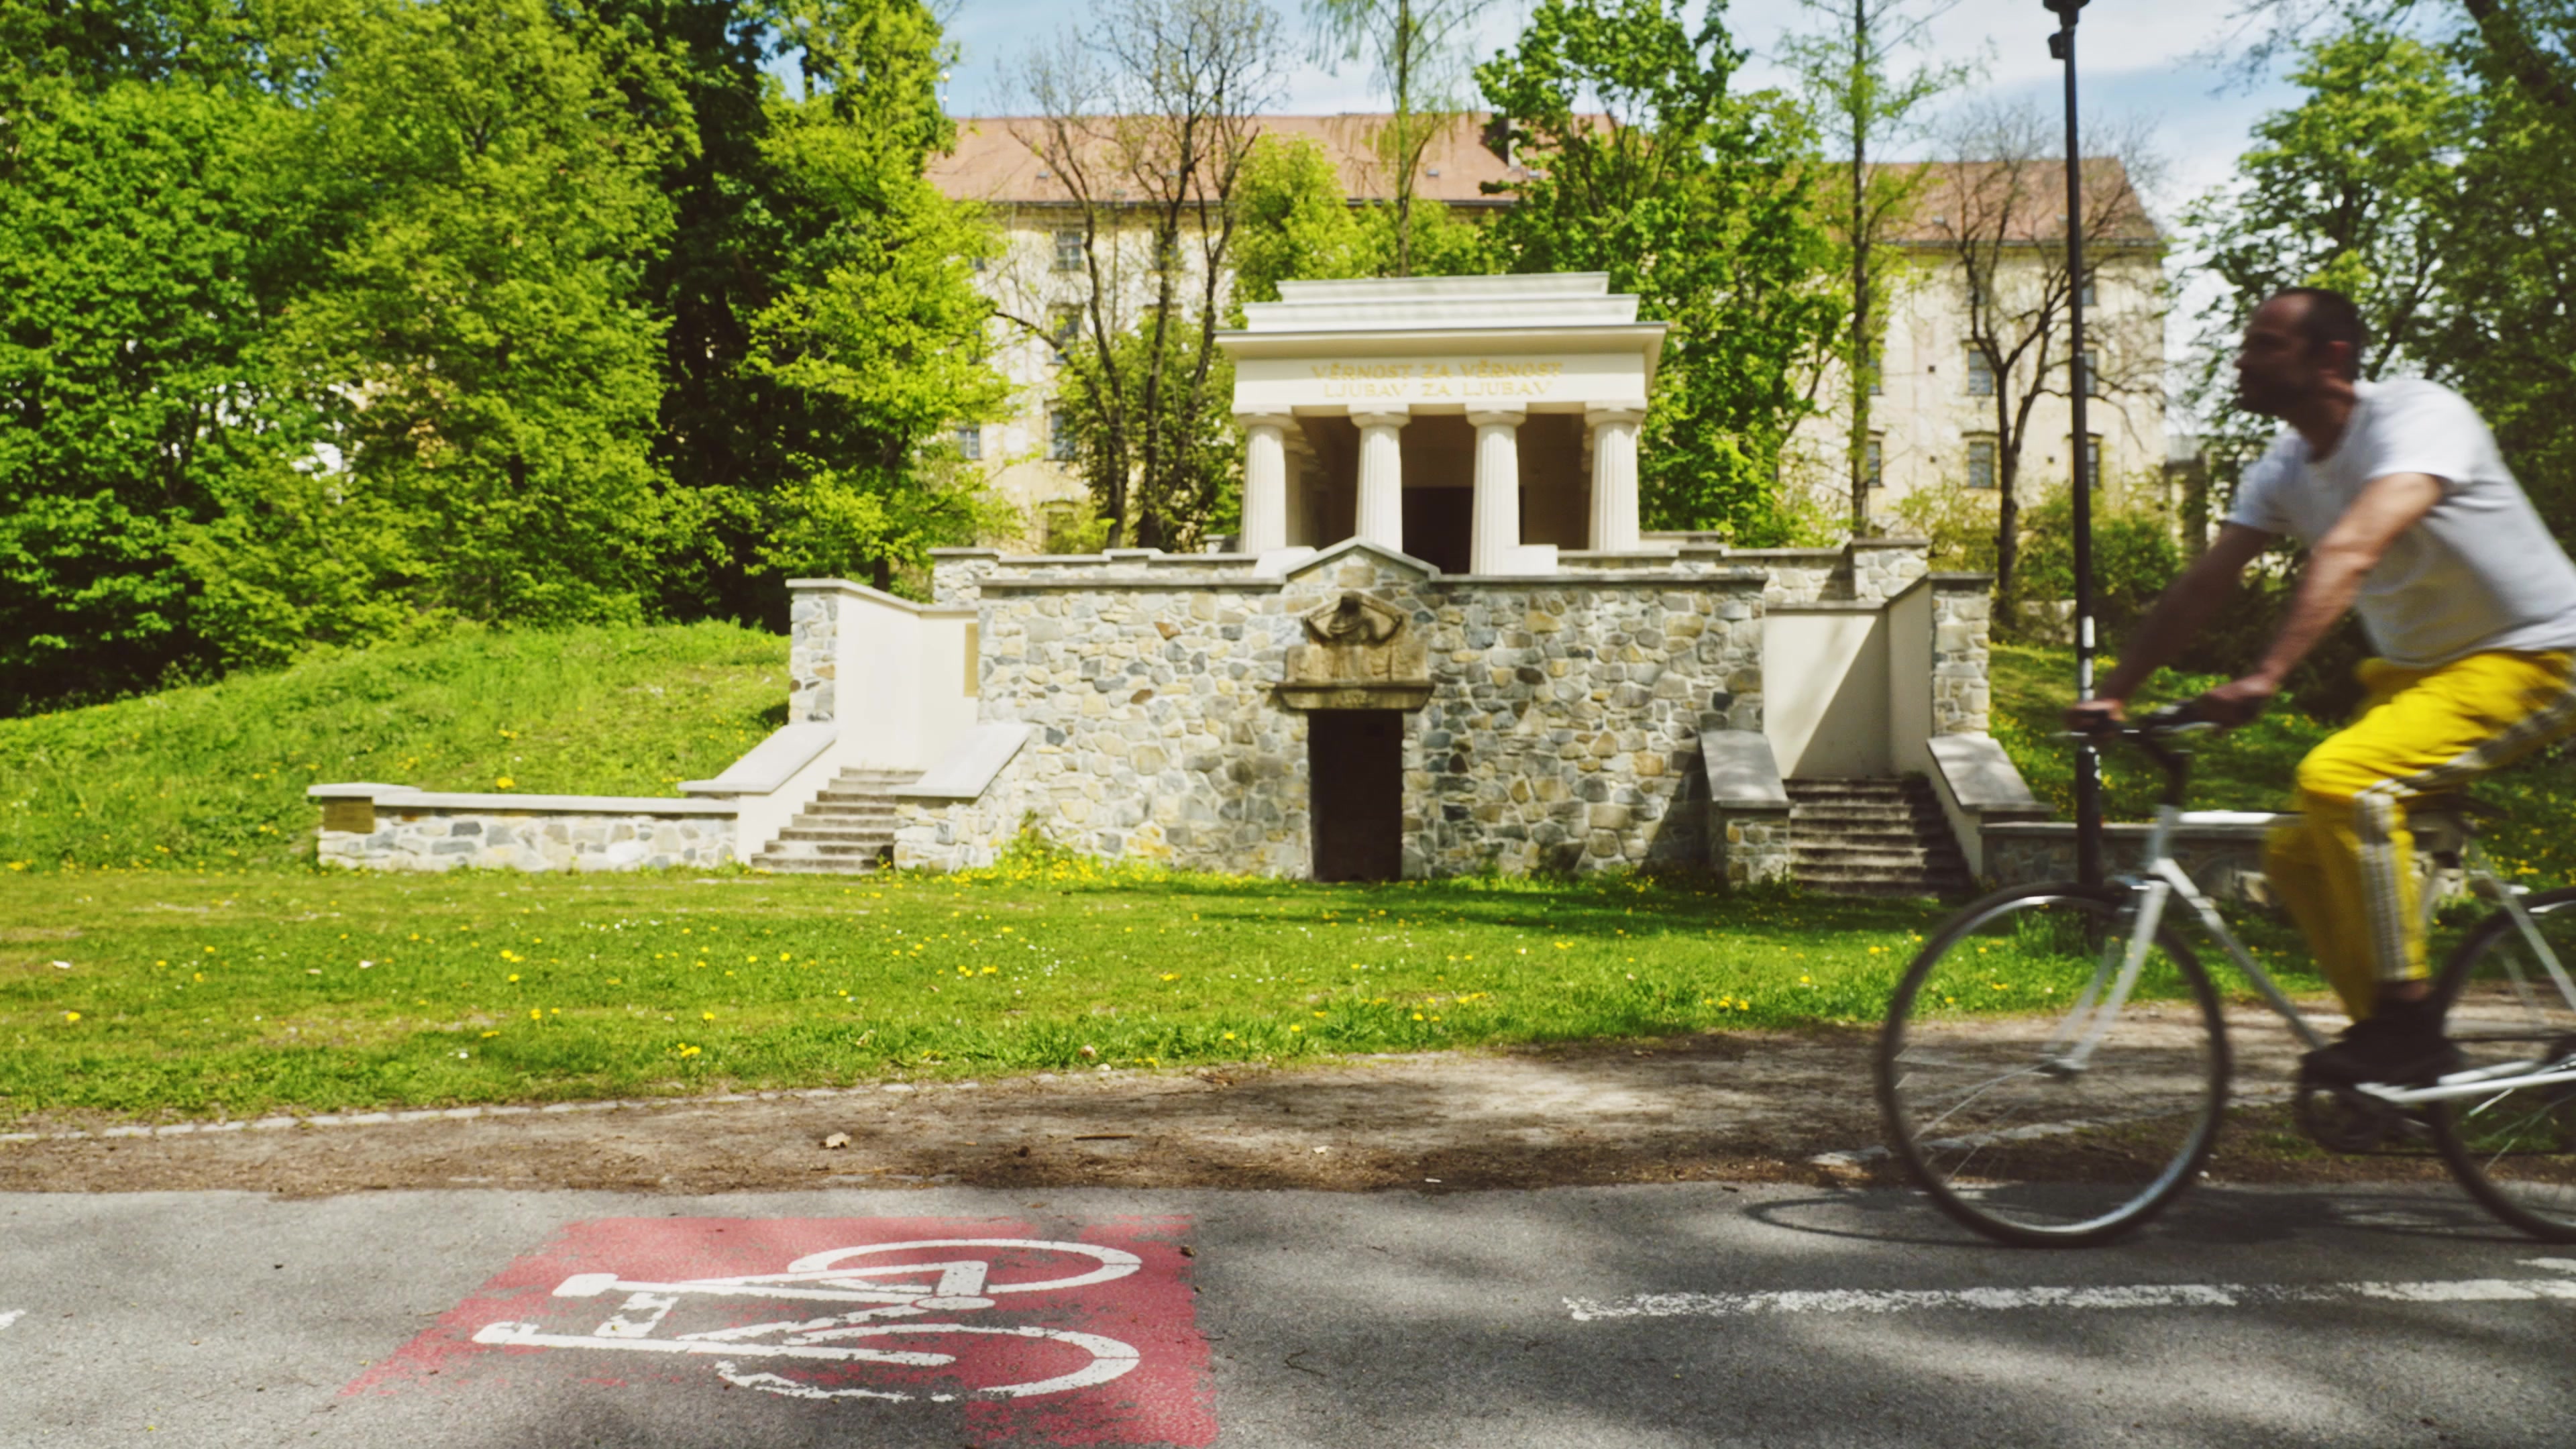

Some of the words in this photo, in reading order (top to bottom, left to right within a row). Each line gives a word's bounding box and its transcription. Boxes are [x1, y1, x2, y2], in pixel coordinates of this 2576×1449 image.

[1421, 364, 1453, 378] ZA
[1324, 382, 1408, 398] LJUBAV
[1421, 382, 1452, 397] ZA
[1462, 380, 1552, 396] LJUBAV
